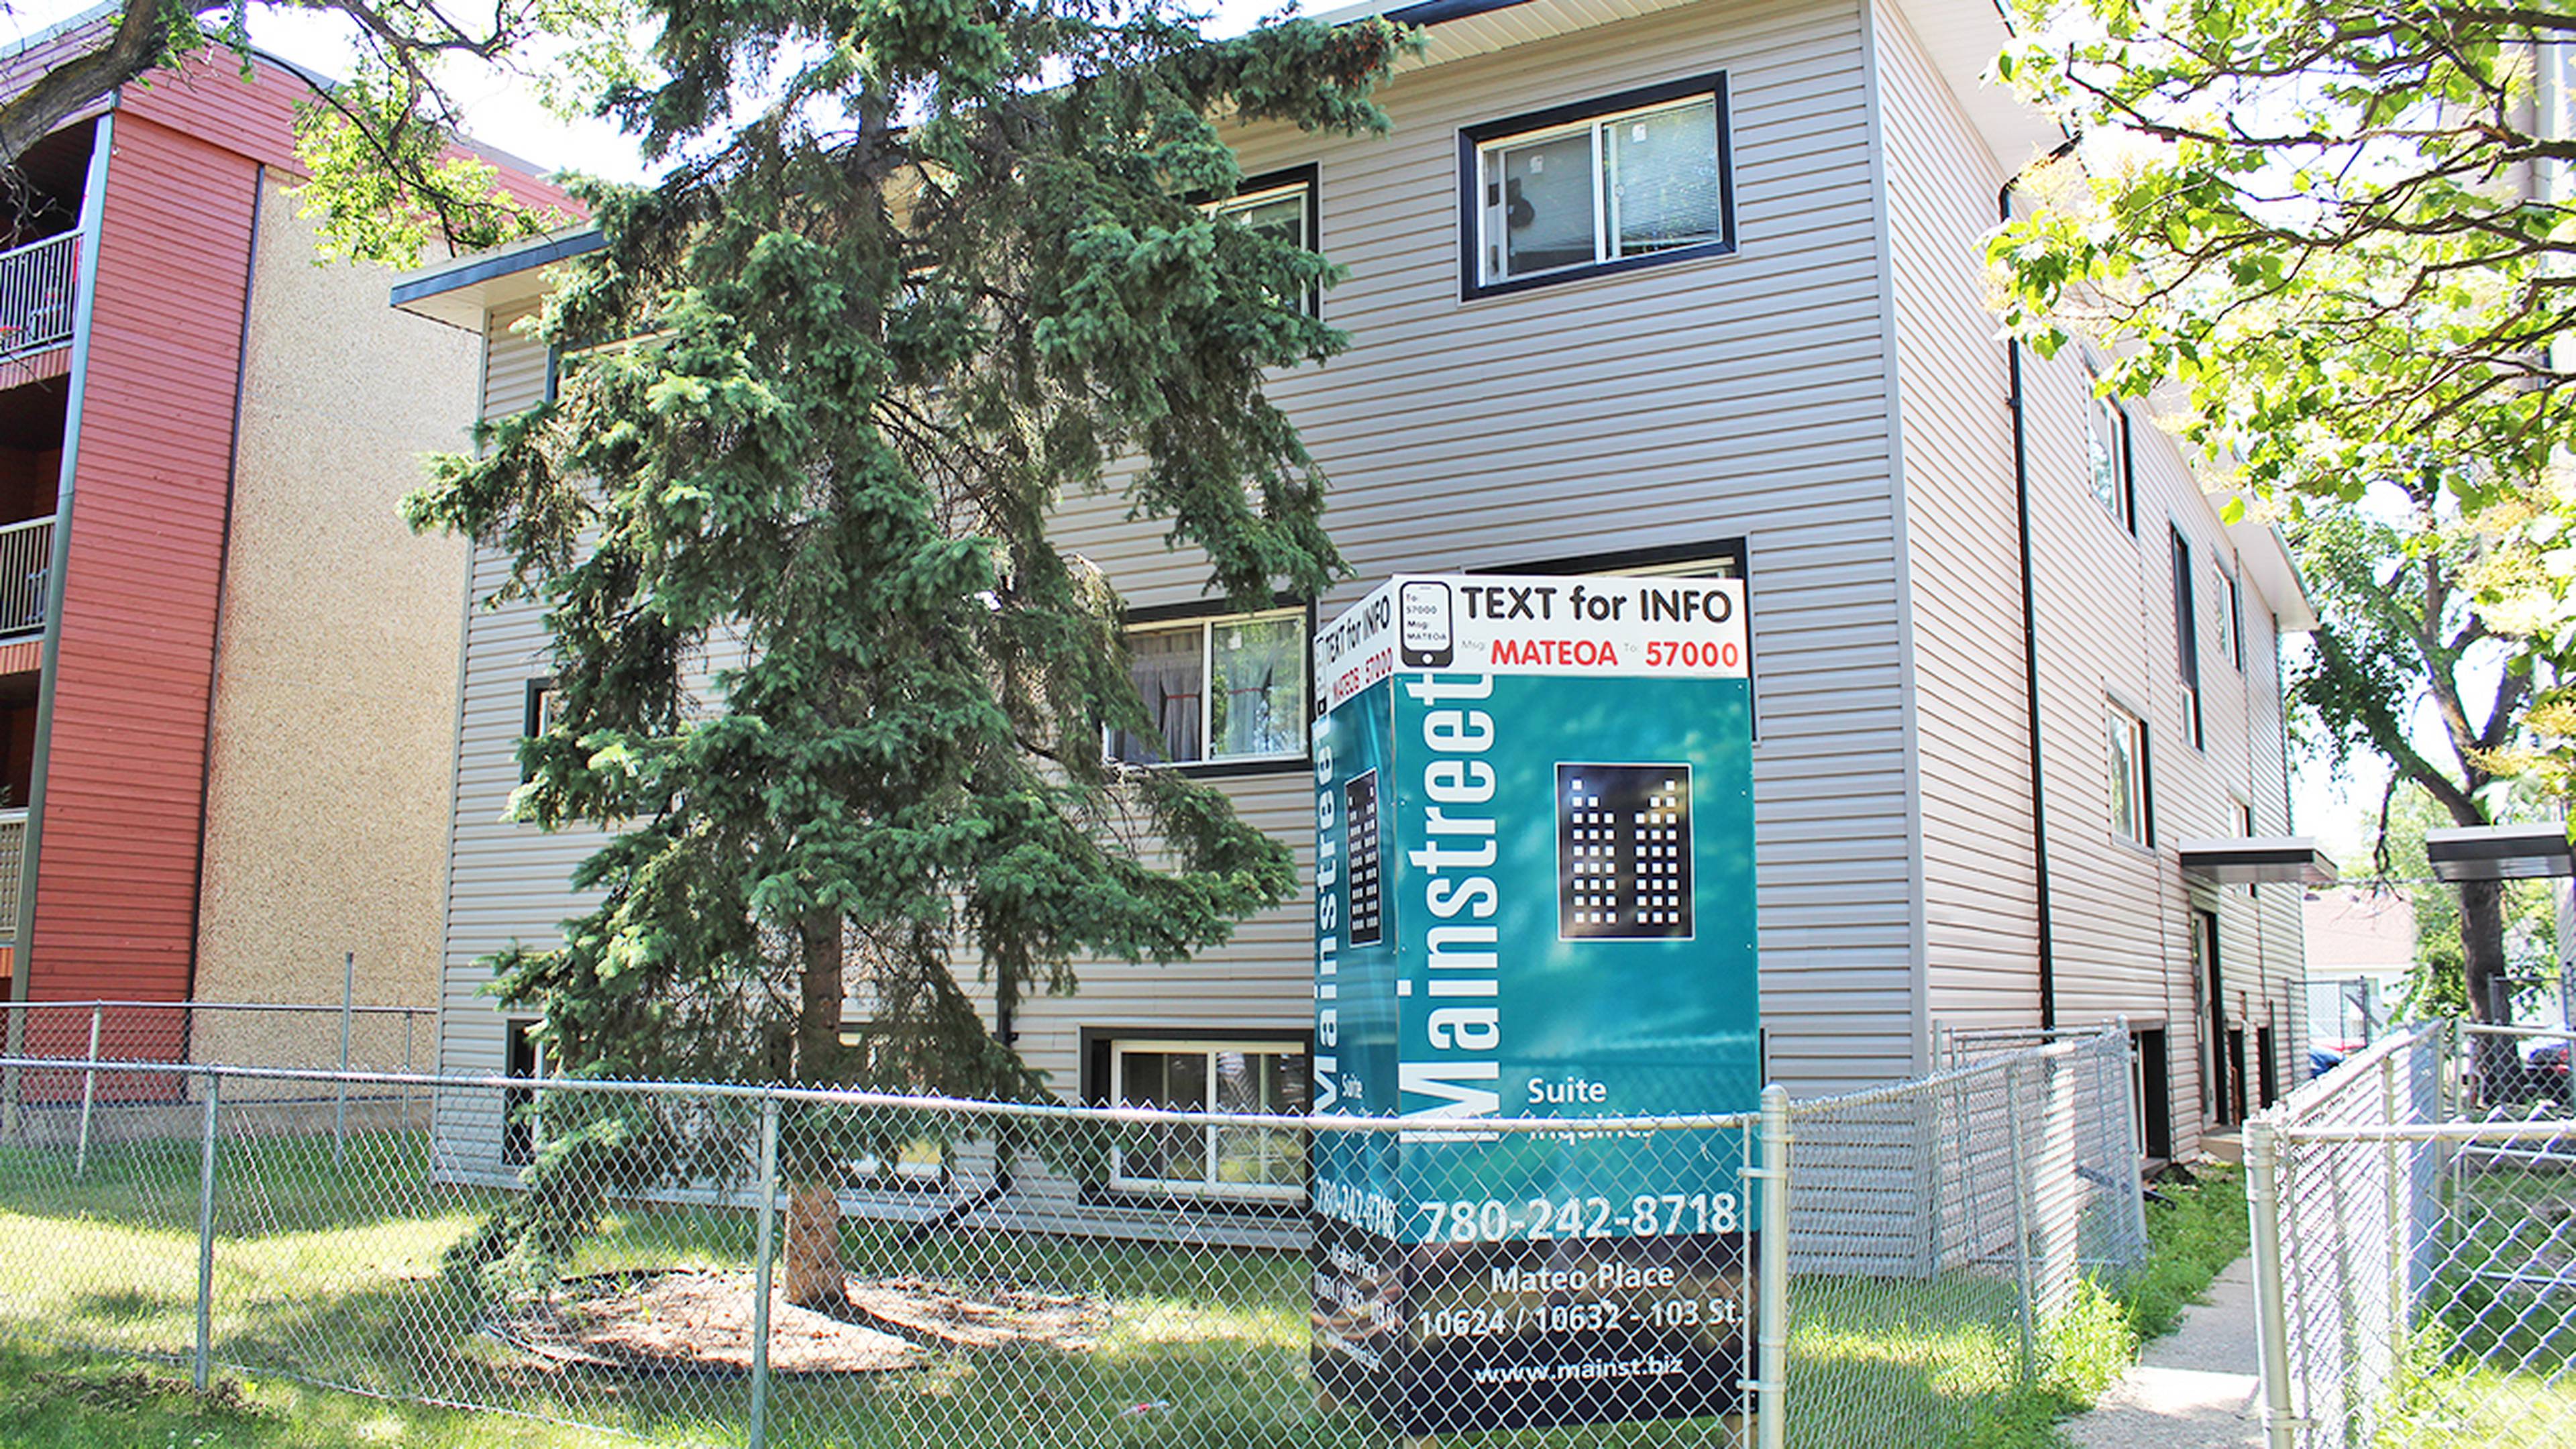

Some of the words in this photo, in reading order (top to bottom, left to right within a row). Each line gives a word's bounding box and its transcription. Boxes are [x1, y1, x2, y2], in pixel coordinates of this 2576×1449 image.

[1362, 594, 1391, 641] INFO
[1460, 586, 1558, 621] TEXT
[1569, 584, 1627, 621] for
[1640, 588, 1733, 623] INFO
[1491, 639, 1619, 665] MATEOA
[1645, 641, 1739, 667] 57000
[1397, 673, 1501, 1143] Mainstreet
[1527, 1076, 1607, 1104] Suite
[1421, 1191, 1737, 1244] 780-242-8718
[1491, 1265, 1587, 1294] Mateo
[1598, 1262, 1675, 1289] Place
[1418, 1307, 1506, 1338] 10624
[1536, 1301, 1621, 1334] 10632
[1650, 1299, 1700, 1327] 103
[1474, 1355, 1684, 1385] www.mainst.biz
